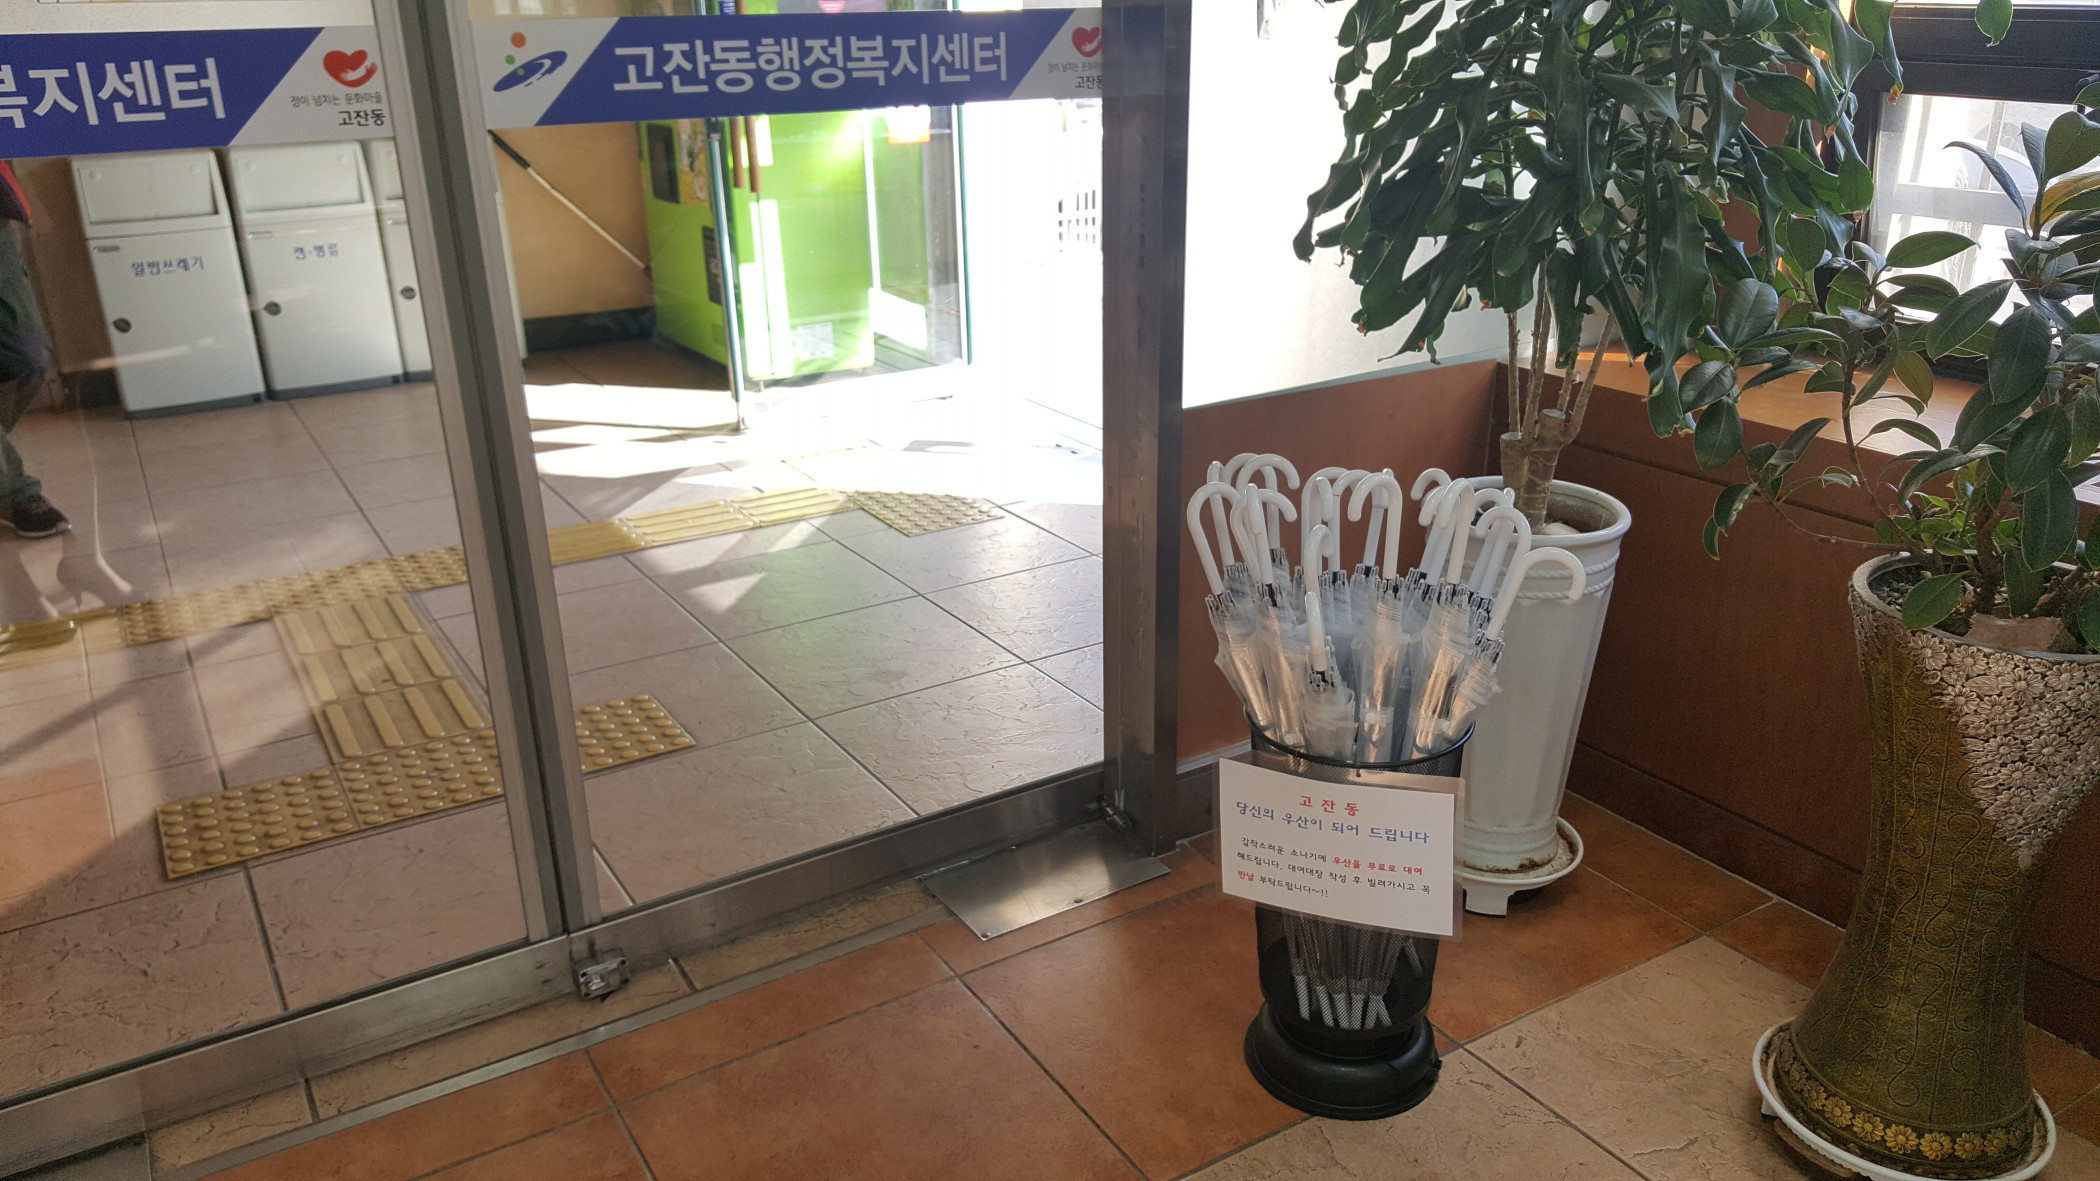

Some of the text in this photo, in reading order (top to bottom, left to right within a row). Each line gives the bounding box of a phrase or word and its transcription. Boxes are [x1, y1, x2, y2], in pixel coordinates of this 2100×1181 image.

[612, 31, 1008, 94] 고잔동행정복지센터
[338, 108, 386, 127] 고잔동
[1236, 801, 1430, 844] 당신의 우산이 되어 드립니다
[1237, 851, 1431, 895] 해드립니다. 대여대장 작성 후 빌려가시고 꼭
[1237, 869, 1255, 882] 반납
[1290, 849, 1327, 863] 소나기에
[1332, 856, 1361, 870] 우산을
[1367, 862, 1397, 873] 무료로
[1403, 866, 1423, 876] 대여
